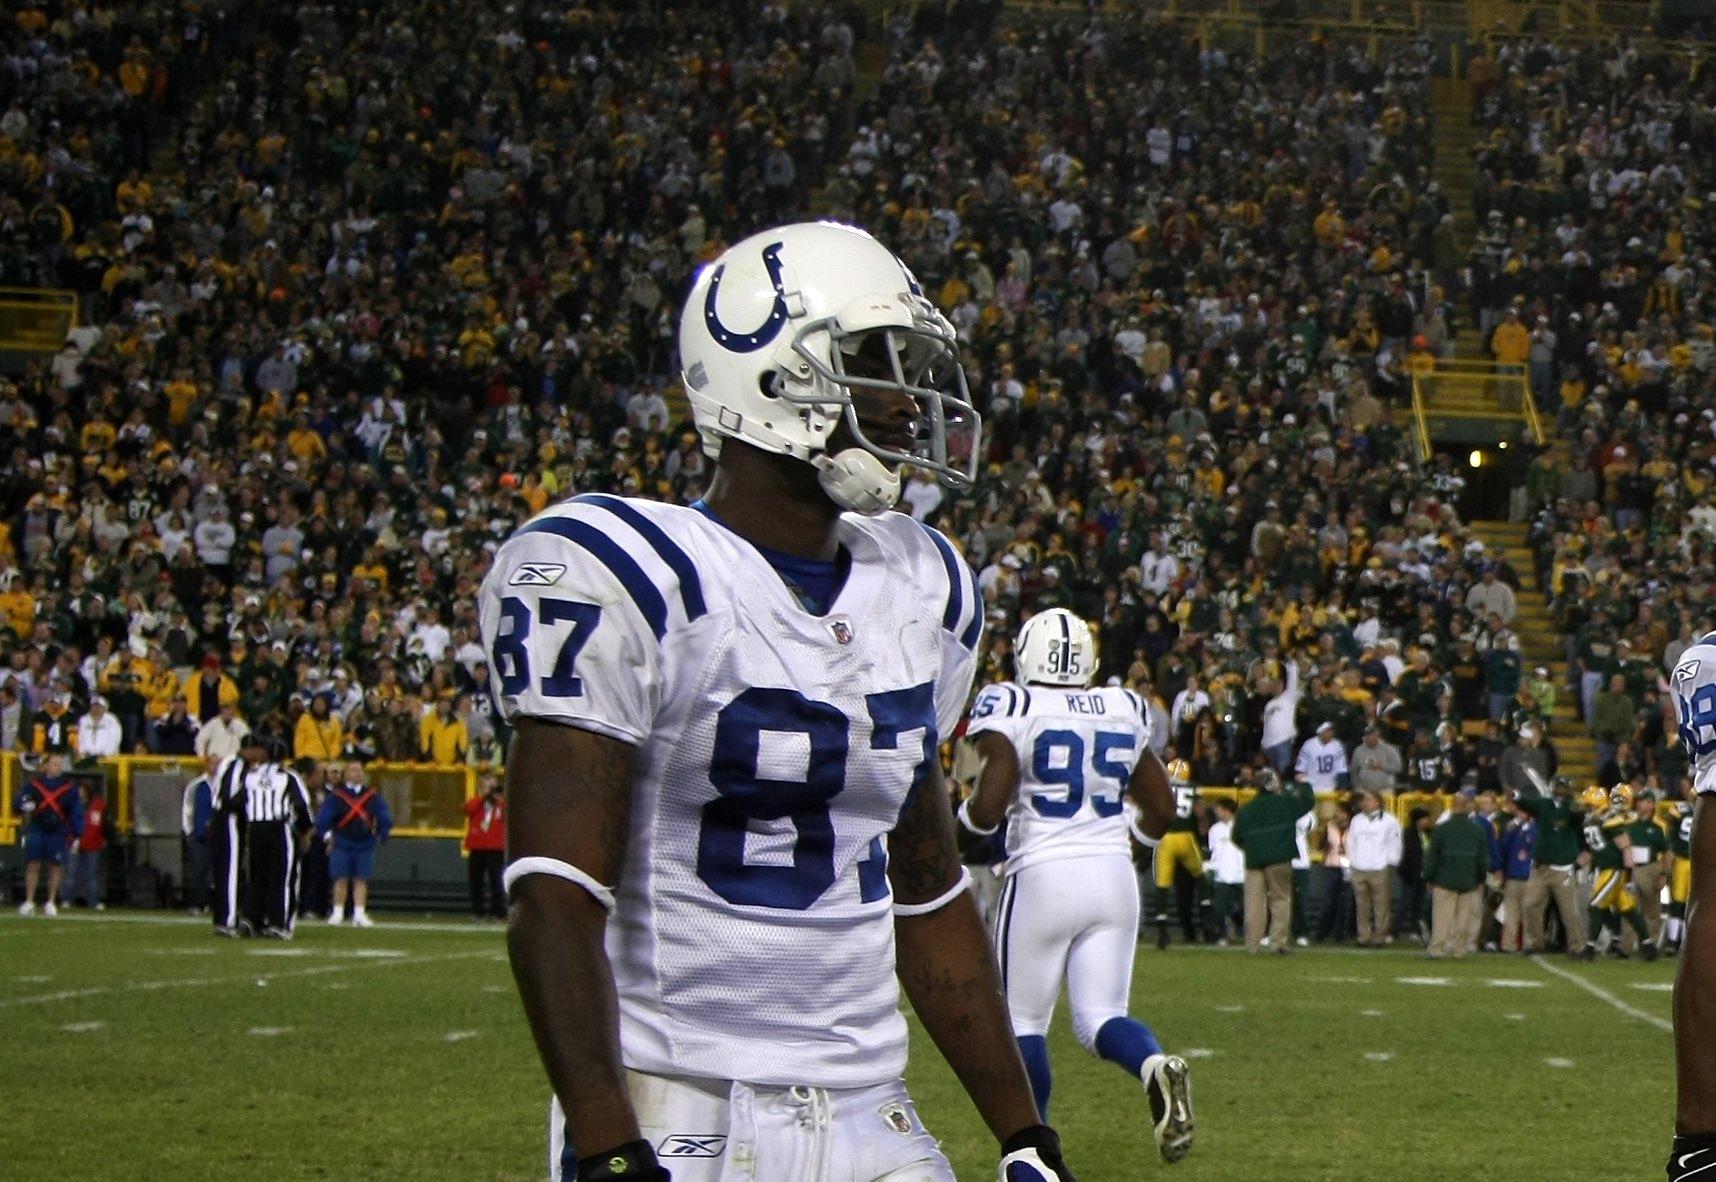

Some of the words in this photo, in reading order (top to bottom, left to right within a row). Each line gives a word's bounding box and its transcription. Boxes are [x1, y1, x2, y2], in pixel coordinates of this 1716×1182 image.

[493, 596, 603, 697] 87
[1047, 651, 1080, 675] 95
[1064, 694, 1106, 715] REID
[697, 680, 938, 911] 87
[1031, 730, 1136, 818] 95
[1174, 787, 1195, 818] 5
